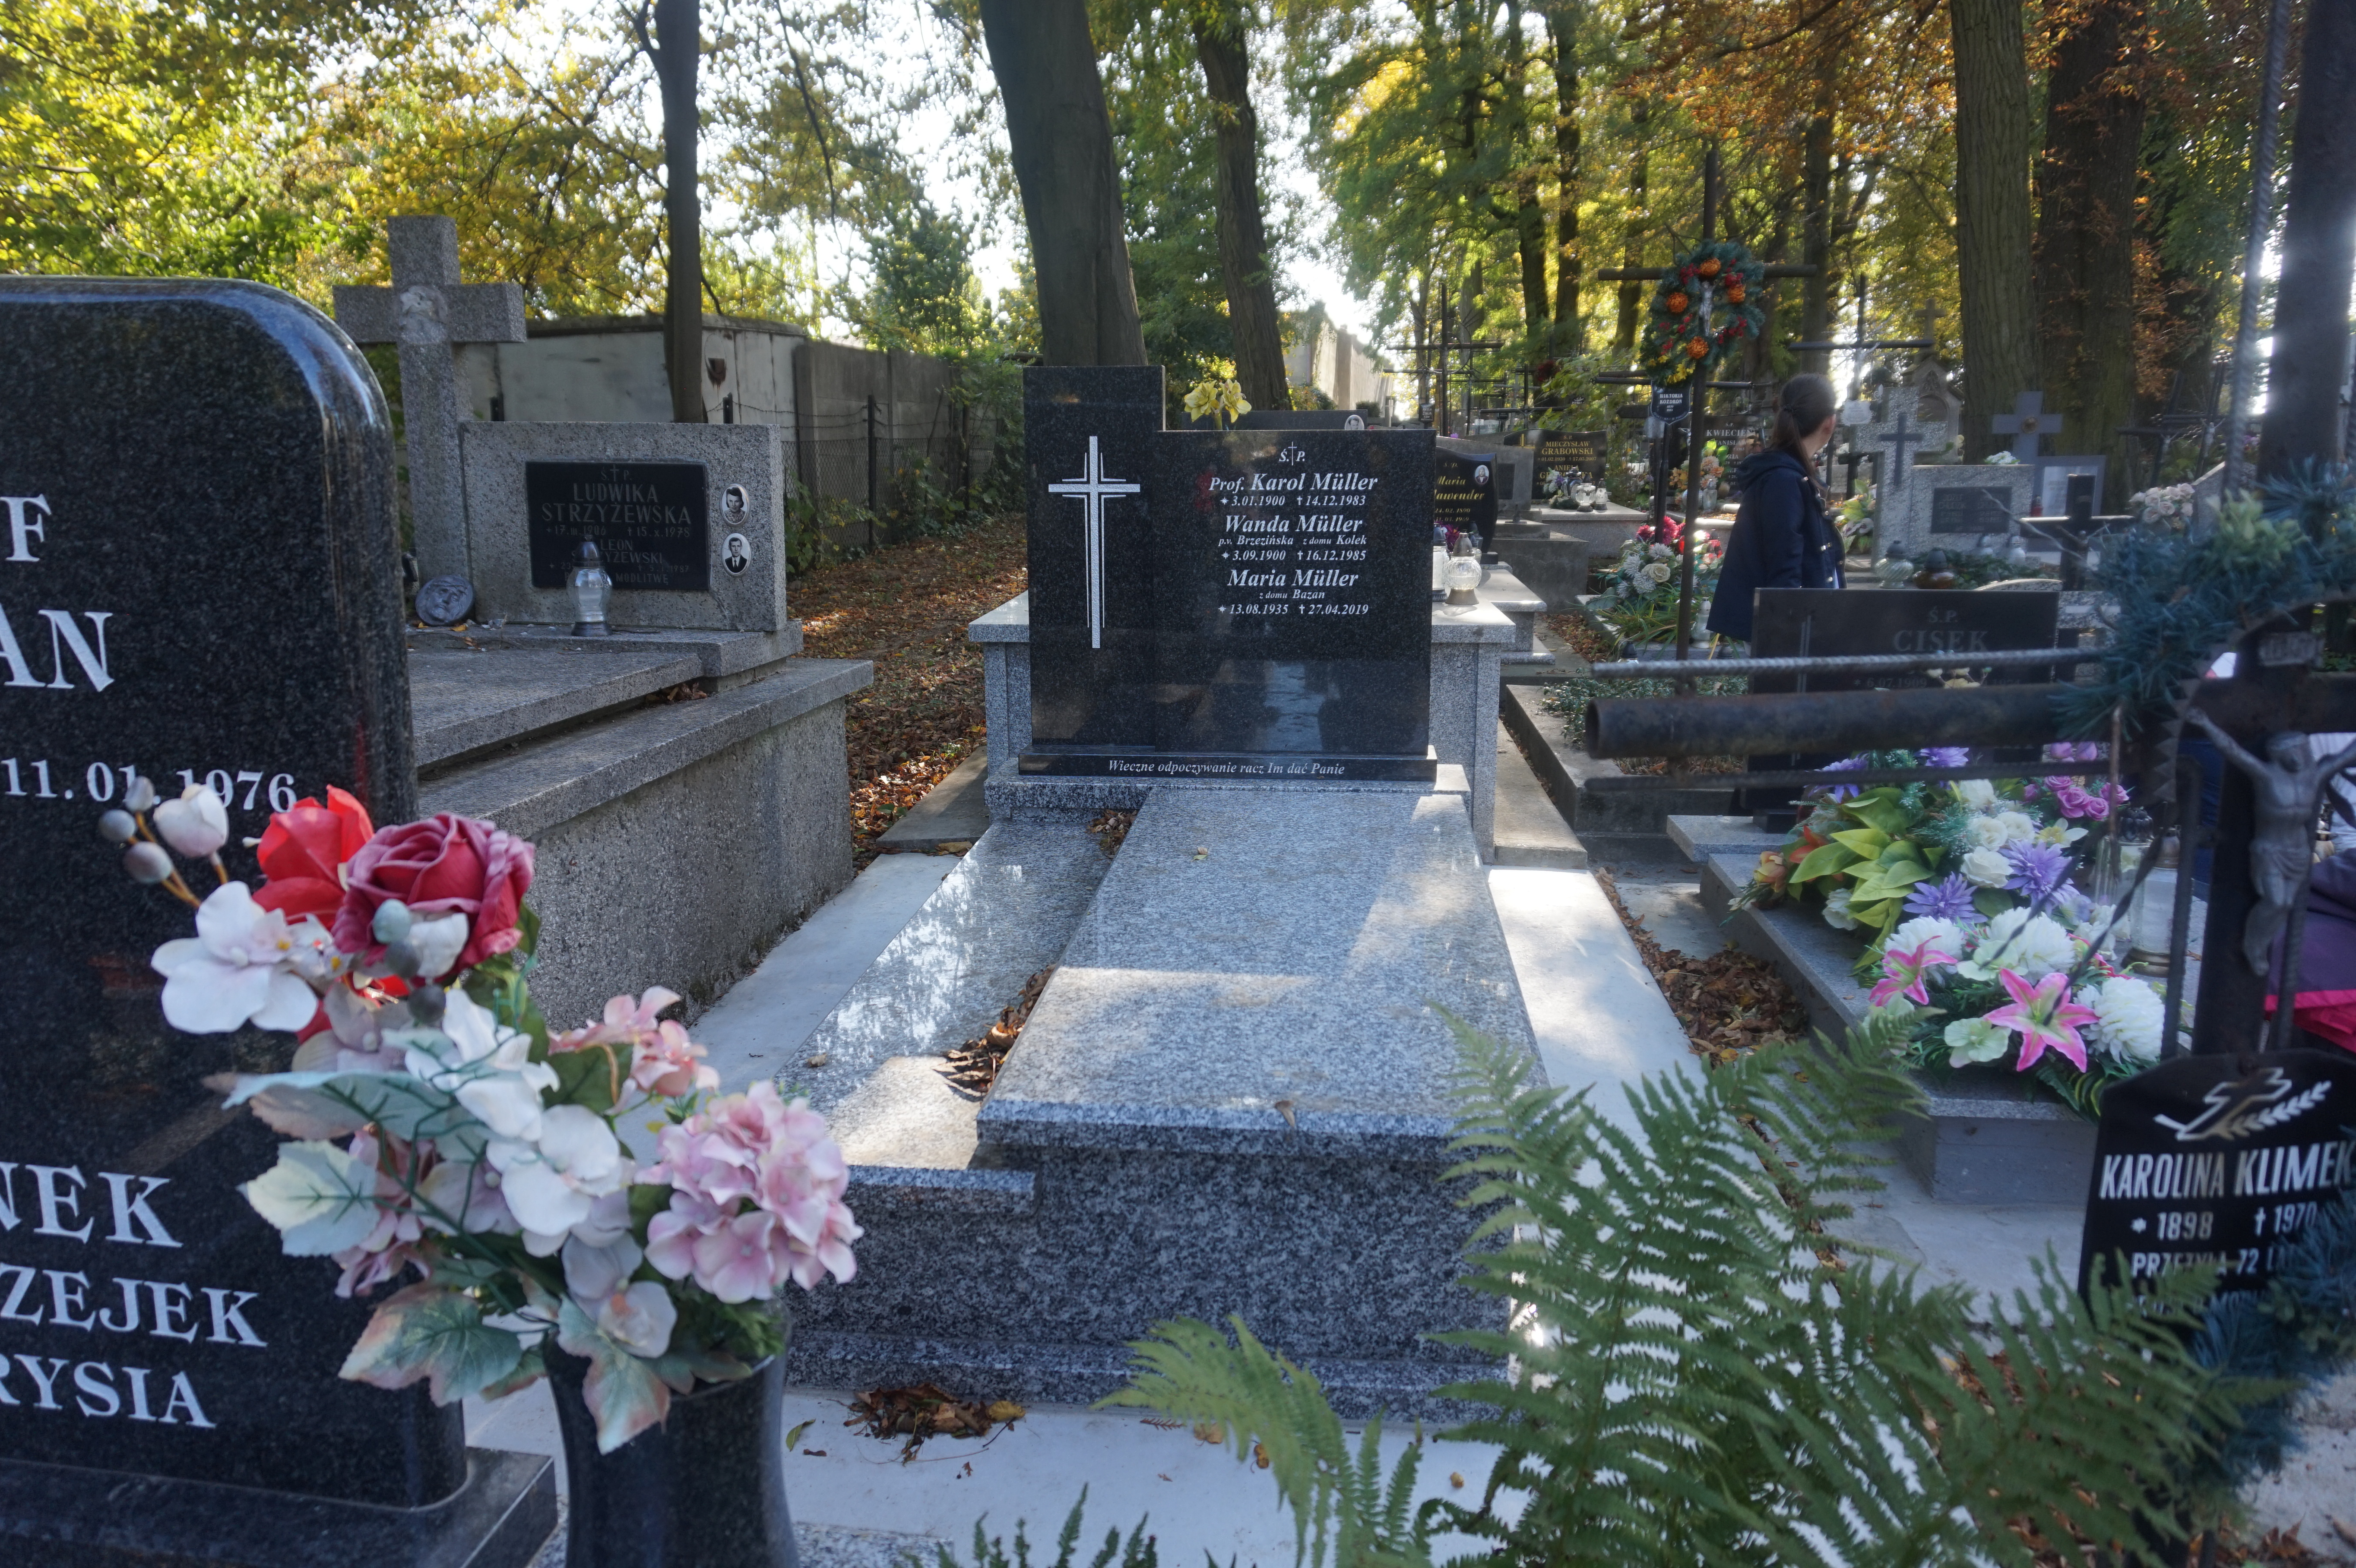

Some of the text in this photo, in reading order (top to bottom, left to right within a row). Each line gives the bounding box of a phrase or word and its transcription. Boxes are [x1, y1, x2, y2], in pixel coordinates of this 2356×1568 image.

[1209, 472, 1378, 494] Prof. Karol Müller
[573, 482, 659, 503] LUDWIKA
[1231, 495, 1366, 506] 3.01.1900 14.12.1983
[542, 502, 691, 524] STRZYŻEWSKA
[1226, 515, 1363, 533] Wanda Müller
[600, 539, 634, 551] LEON
[1218, 538, 1232, 547] p.v.
[1236, 534, 1295, 546] Brzezińska
[1308, 536, 1331, 544] domu
[1335, 534, 1368, 545] Kolek
[1232, 550, 1367, 561] 3.09.1900 16.12.1985
[1226, 569, 1359, 586] Maria Müller
[1265, 590, 1288, 599] domu
[1291, 588, 1325, 600] Bazan
[1229, 604, 1369, 615] 13.08.1935 27.04.2019
[1893, 630, 1989, 652] CISEK
[1109, 759, 1346, 775] Wieczne odpoczywanie racz Im dać Panie
[2097, 1141, 2356, 1200] KAROLINA KLIMEK
[2157, 1211, 2214, 1241] 1898
[2236, 1247, 2259, 1275] 72
